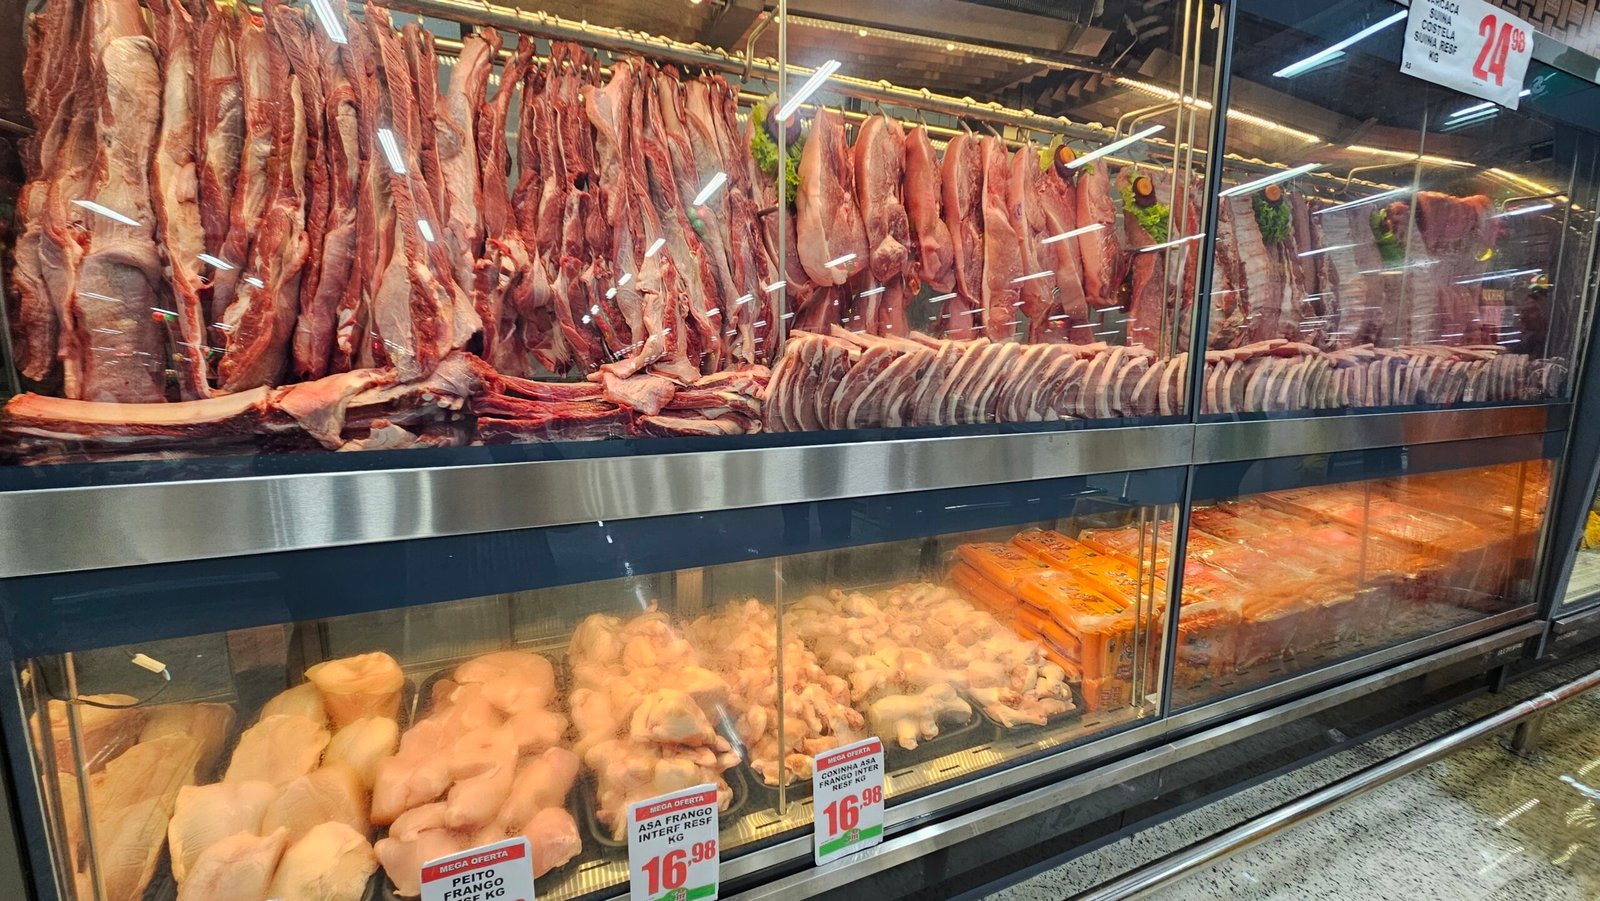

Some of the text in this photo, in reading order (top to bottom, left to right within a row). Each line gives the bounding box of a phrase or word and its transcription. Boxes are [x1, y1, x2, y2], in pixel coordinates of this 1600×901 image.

[1427, 0, 1459, 15] RCACA
[1429, 8, 1451, 26] SUINA
[1421, 19, 1455, 41] COSTELA
[1413, 31, 1458, 55] SUINA RESF
[1428, 50, 1439, 63] KG
[828, 746, 871, 764] MEGA OFERTA
[819, 763, 879, 789] FRANGO INTER
[821, 757, 876, 780] COXINHA ASA
[832, 775, 866, 791] RESF KG
[649, 795, 704, 814] MEGA OFERTA
[823, 785, 882, 837] 16,98
[638, 807, 713, 833] ASA FRANGO
[638, 816, 713, 843] INTERF RESF
[668, 833, 684, 845] KG
[440, 850, 509, 873] MEGA OFERTA
[641, 839, 717, 896] 16,98
[443, 877, 504, 901] FRANGO
[452, 869, 495, 887] PEITO
[485, 887, 505, 900] KG
